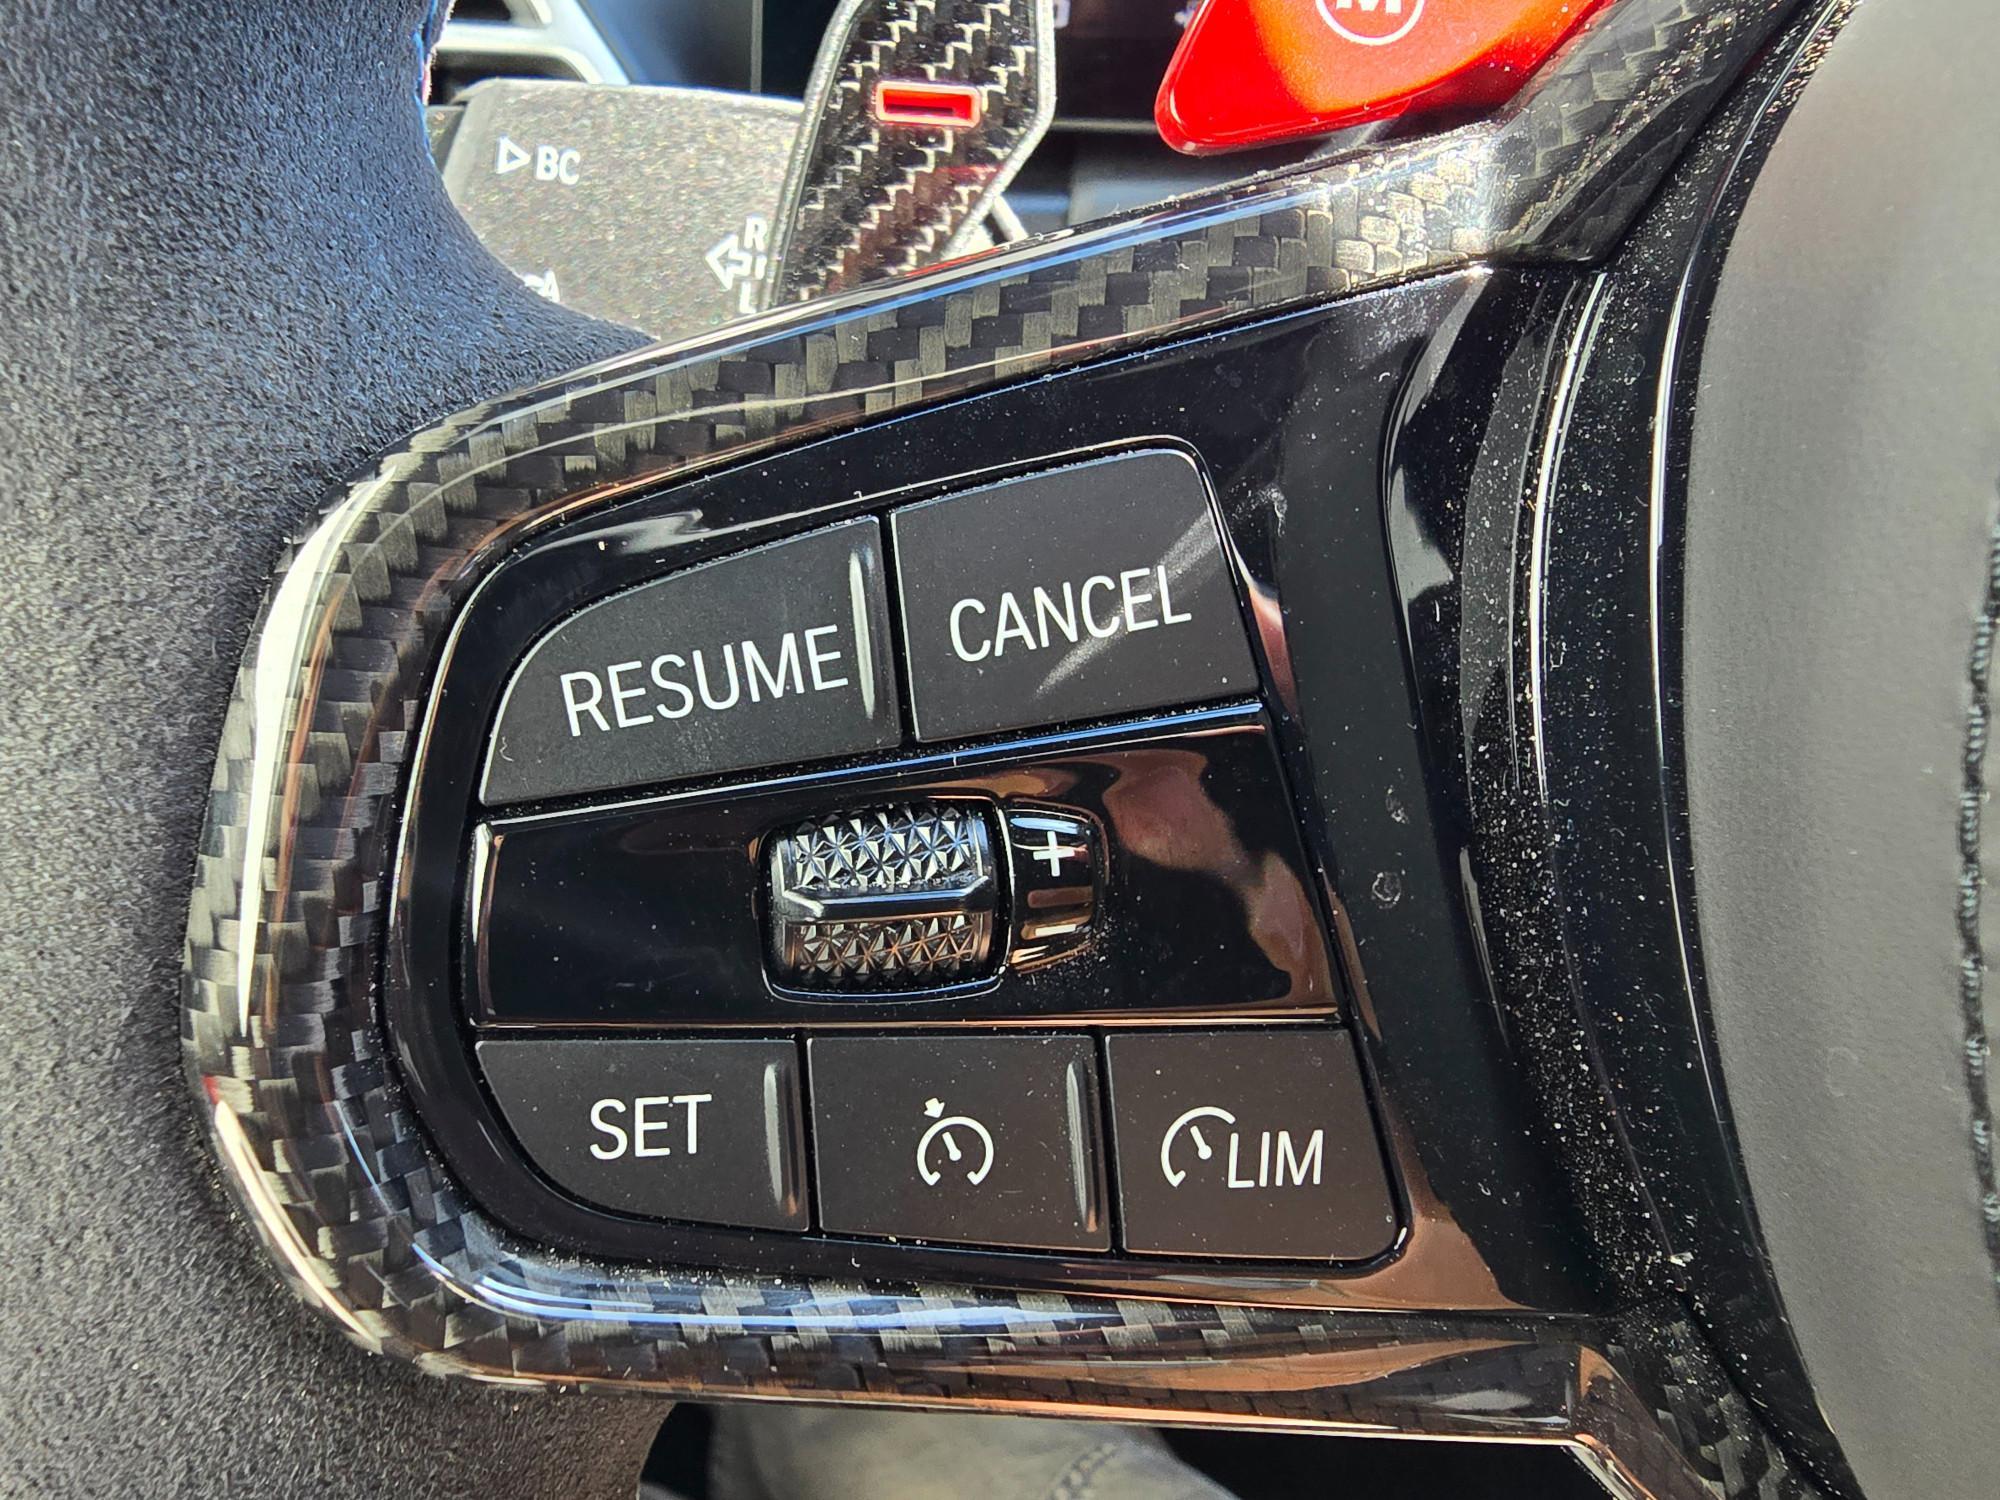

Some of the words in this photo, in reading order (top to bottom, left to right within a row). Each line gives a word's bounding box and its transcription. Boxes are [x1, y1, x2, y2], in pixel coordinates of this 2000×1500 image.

[536, 145, 581, 186] BC
[949, 564, 1192, 662] CANCEL
[560, 624, 849, 737] RESUME
[589, 1093, 713, 1160] SET
[1227, 1129, 1324, 1189] LIM
